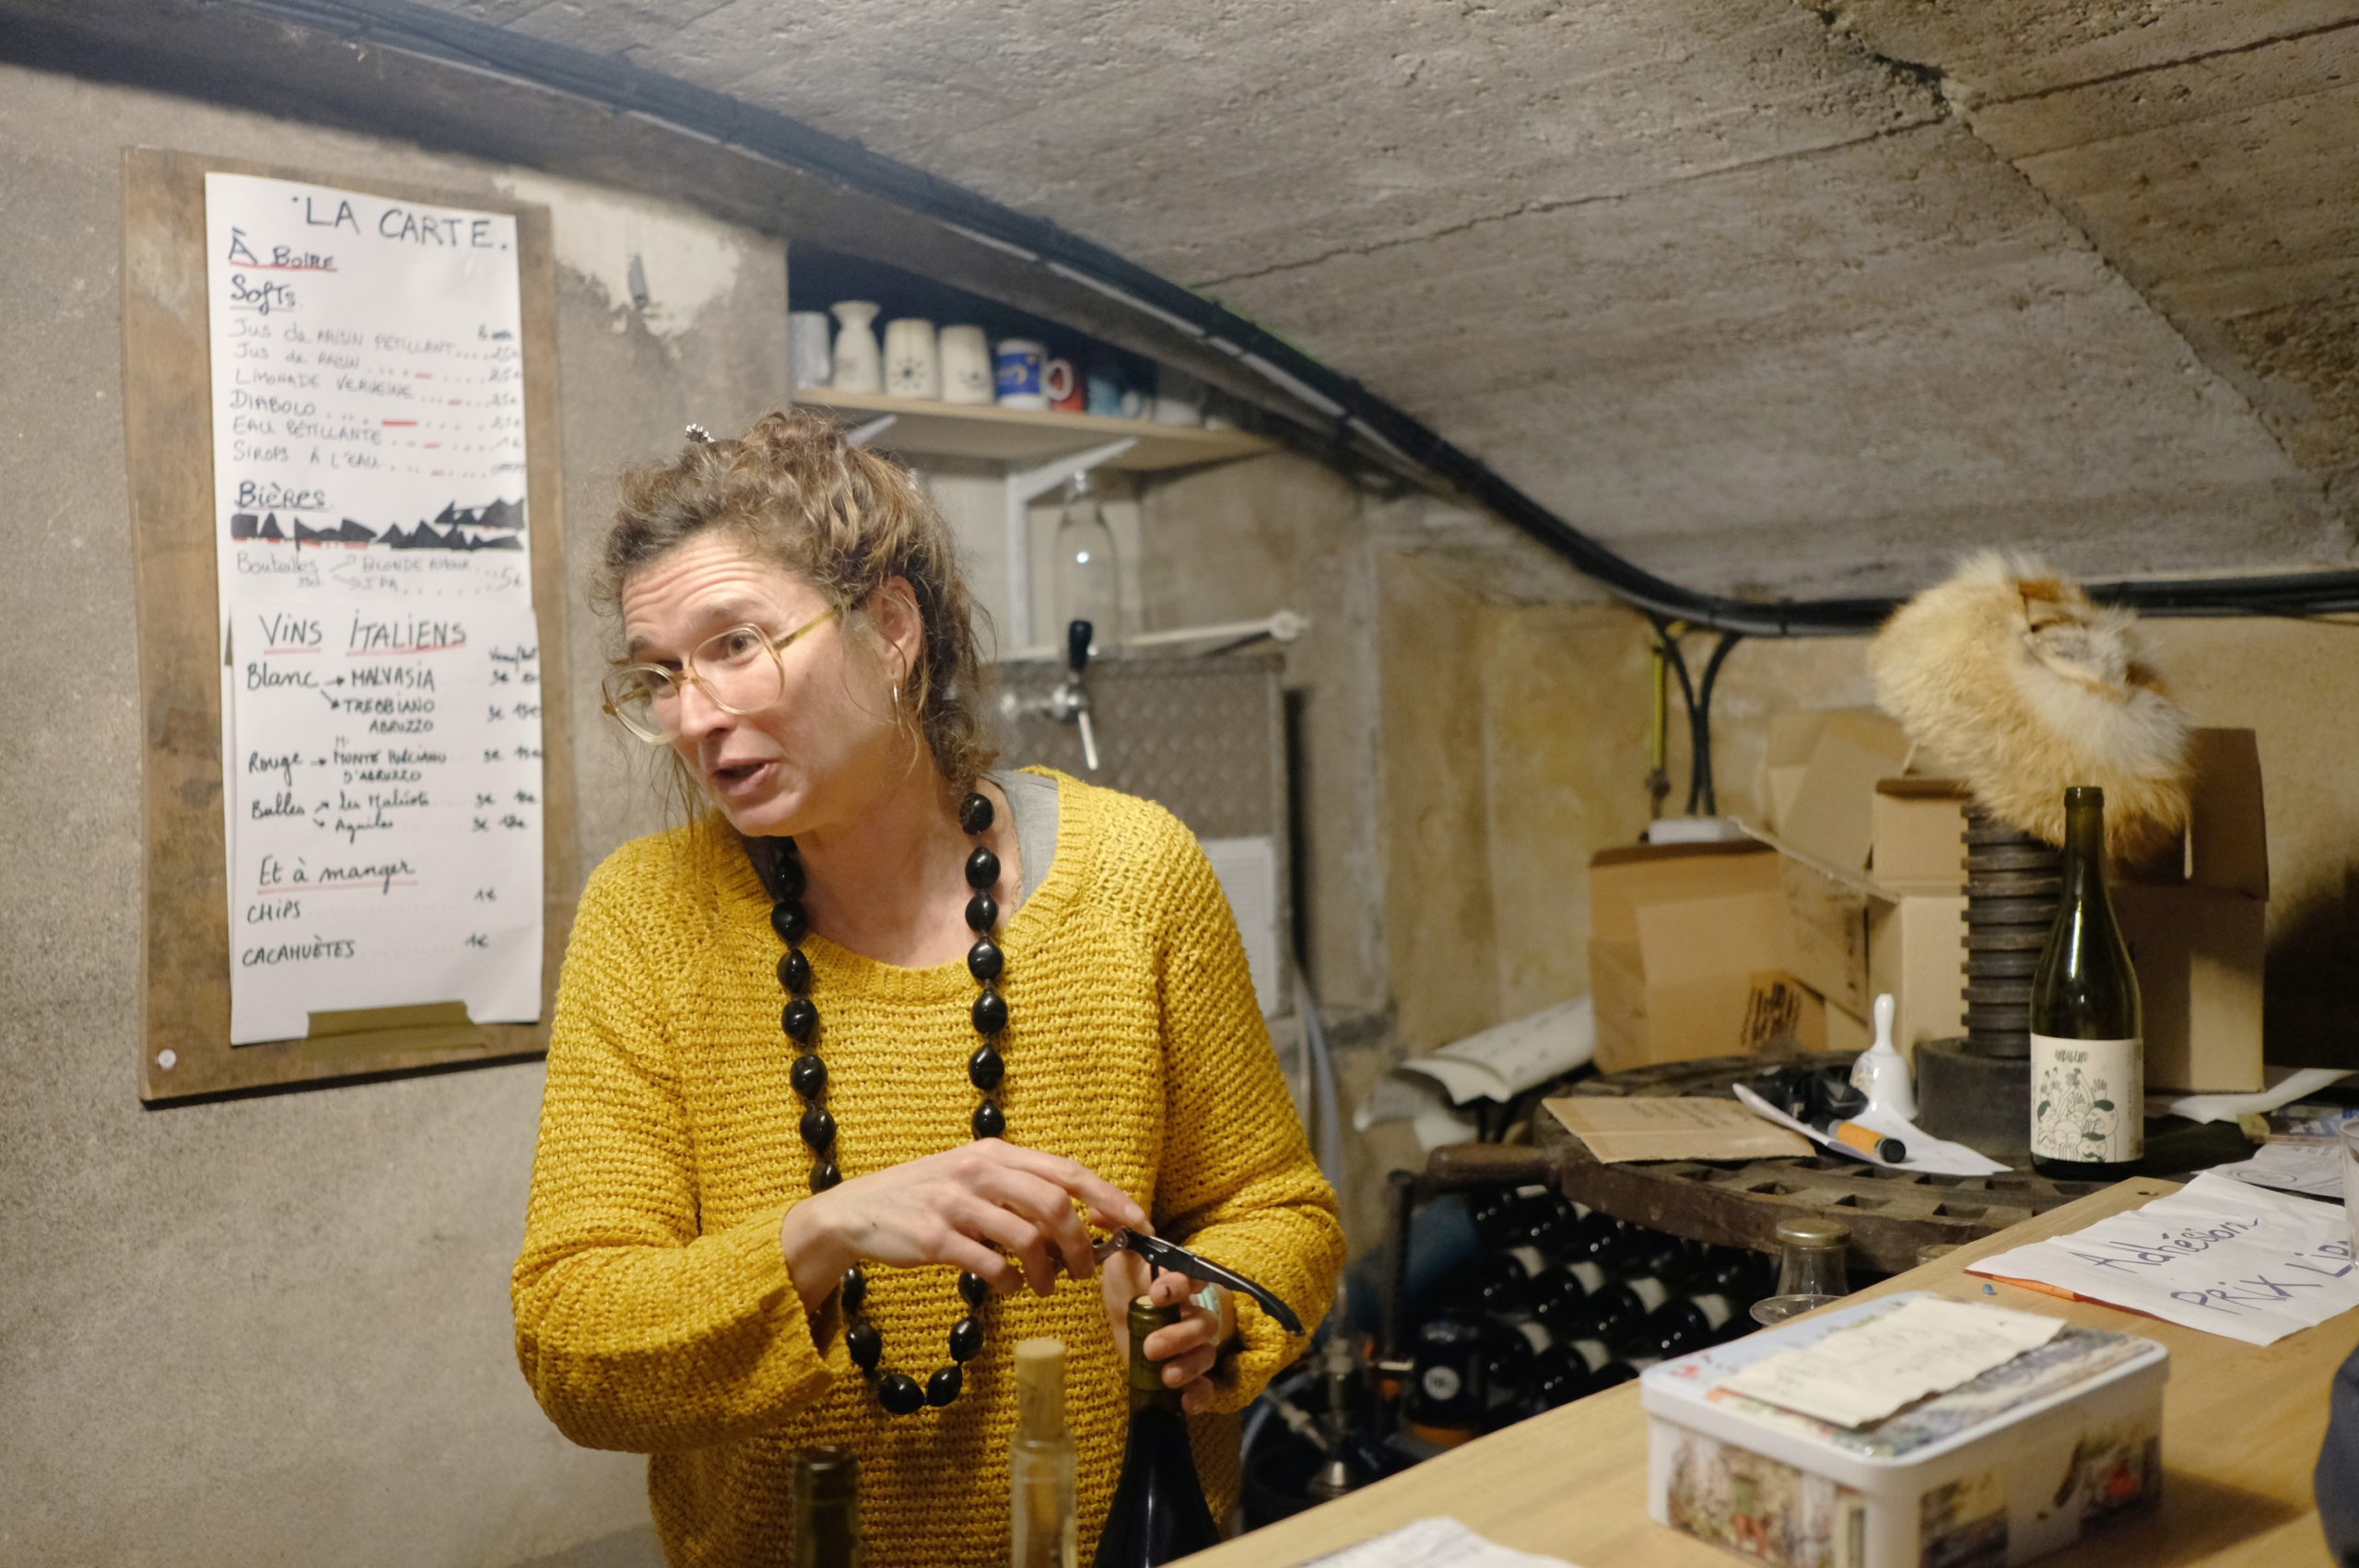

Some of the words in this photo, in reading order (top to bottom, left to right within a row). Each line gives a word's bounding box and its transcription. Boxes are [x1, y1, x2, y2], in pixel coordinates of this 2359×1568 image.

[307, 196, 360, 235] LA
[229, 388, 316, 416] DIABOLO
[247, 661, 319, 692] Blanc
[249, 749, 303, 788] Rouge
[259, 853, 284, 887] Et
[293, 856, 310, 883] à
[319, 859, 417, 895] manger
